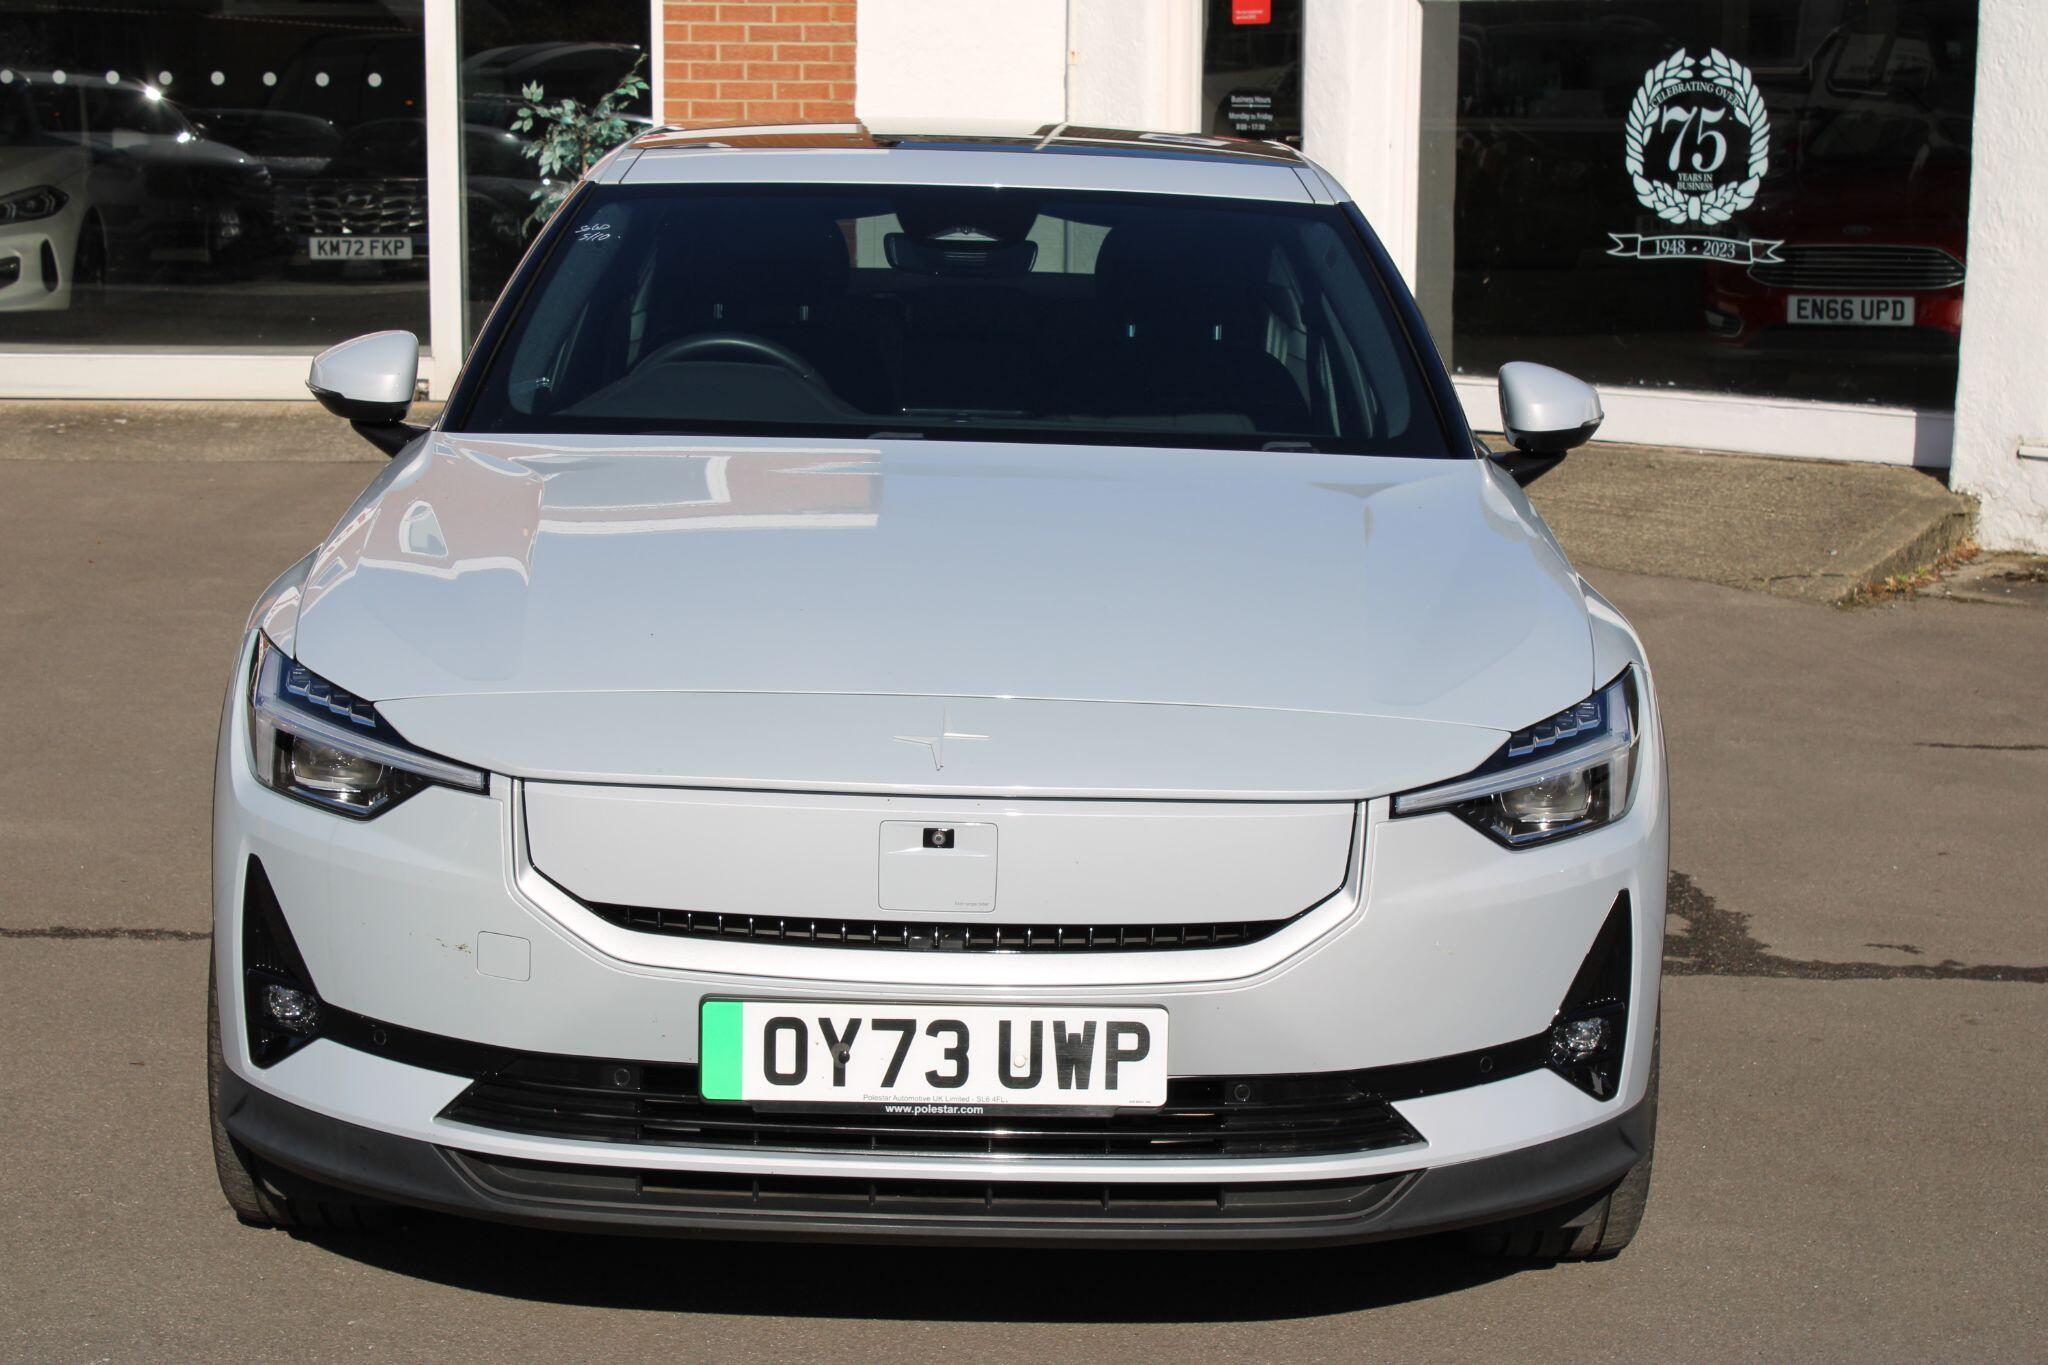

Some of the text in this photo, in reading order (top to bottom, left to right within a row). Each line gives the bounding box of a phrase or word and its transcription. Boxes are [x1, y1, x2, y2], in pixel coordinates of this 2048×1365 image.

[1651, 81, 1740, 108] CELEBRATING OVER
[1228, 112, 1250, 121] Monday
[1256, 112, 1273, 121] Friday
[1661, 105, 1727, 172] 75
[1678, 173, 1713, 181] YEARS IN
[1677, 182, 1713, 190] BUSINESS
[317, 240, 405, 256] KM72 FKP
[1655, 239, 1686, 256] 1948
[1703, 240, 1736, 258] 2023
[1796, 298, 1906, 322] EN66 UPD
[763, 1016, 1151, 1091] OY73 UWP
[863, 1093, 892, 1101] Polestar
[976, 1095, 990, 1103] SL6
[885, 1104, 984, 1115] www.polestar.com
